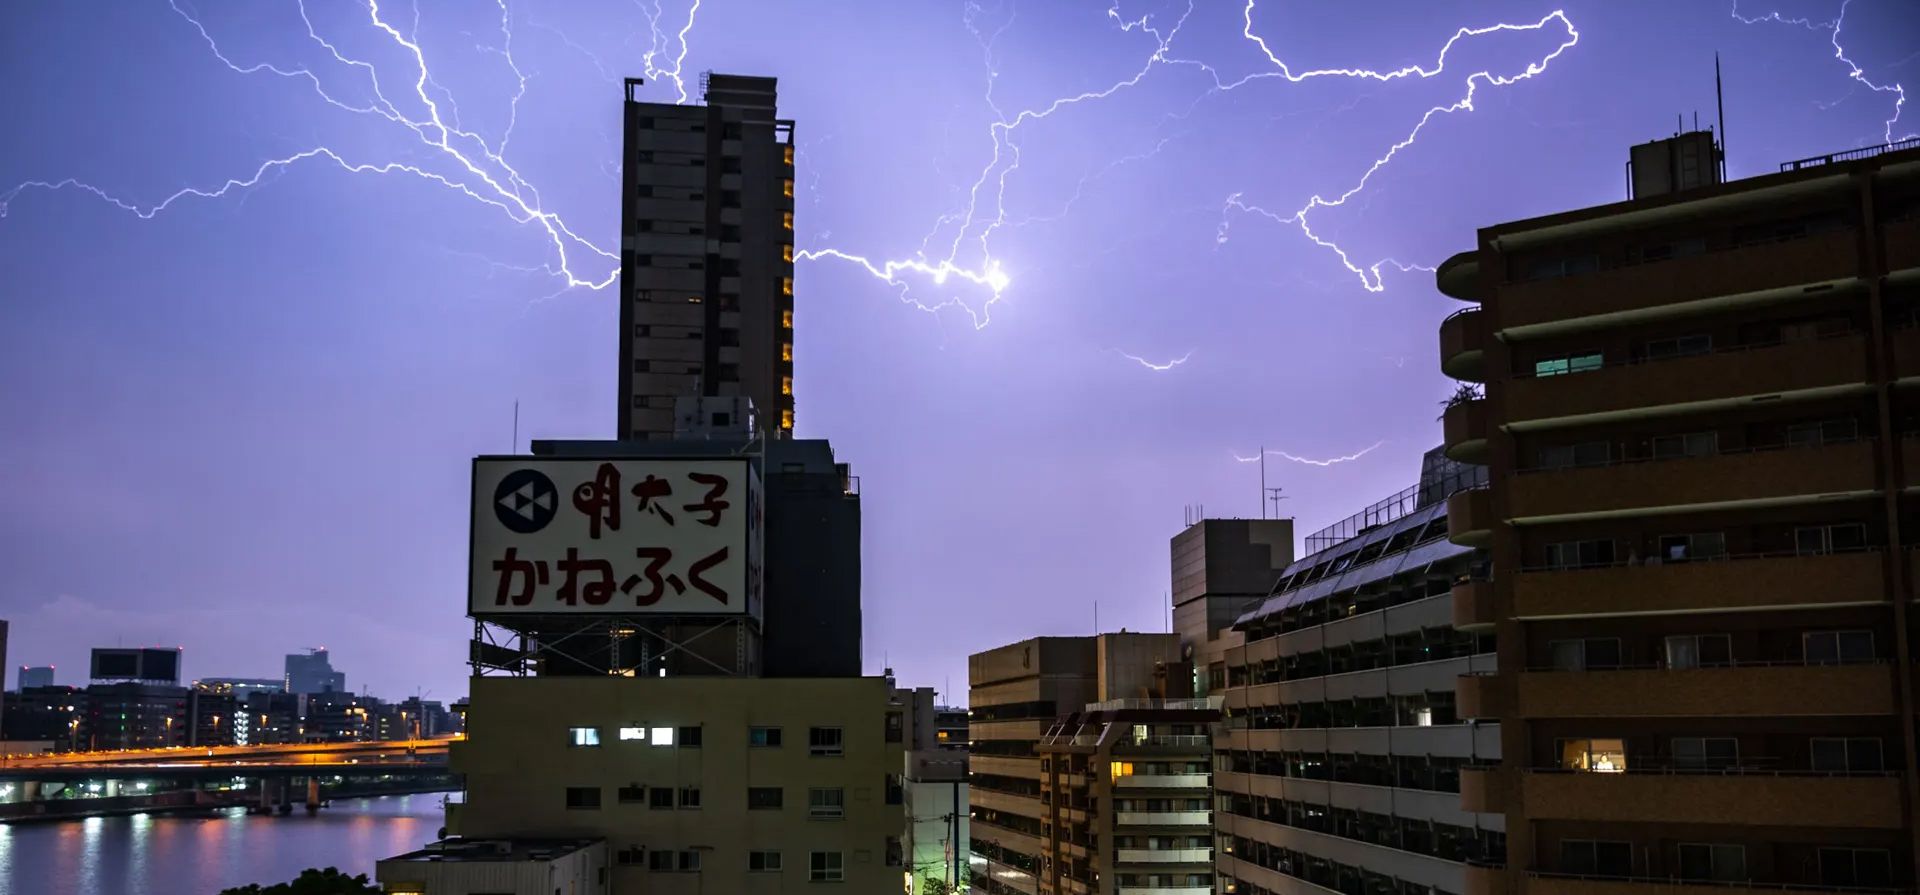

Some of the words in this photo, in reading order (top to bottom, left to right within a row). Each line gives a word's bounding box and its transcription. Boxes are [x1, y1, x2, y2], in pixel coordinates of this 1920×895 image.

[573, 463, 729, 539] 明太子
[493, 546, 728, 606] かねふく
